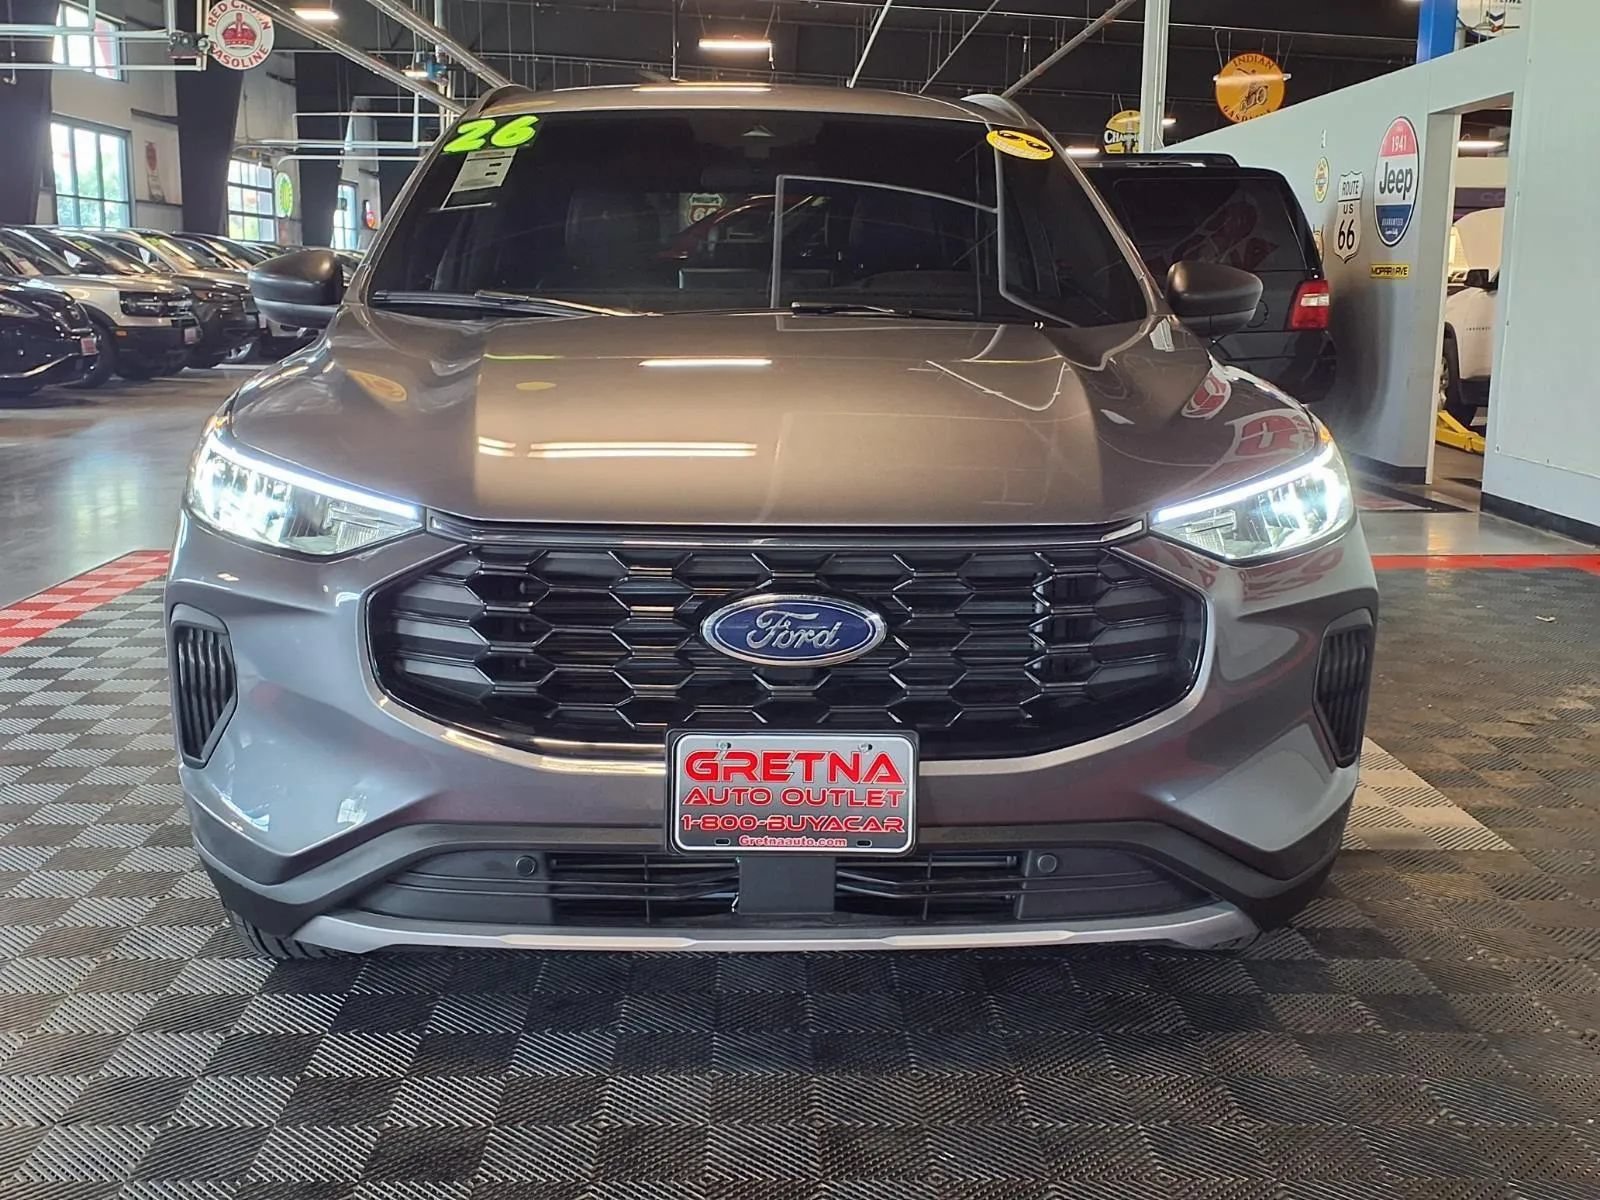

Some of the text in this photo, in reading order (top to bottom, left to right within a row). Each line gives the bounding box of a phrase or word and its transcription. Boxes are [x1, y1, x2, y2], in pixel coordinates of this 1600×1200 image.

[208, 2, 228, 28] RED
[1233, 55, 1274, 70] INDIAN
[443, 115, 539, 153] 26
[1391, 134, 1408, 153] 1941
[1342, 179, 1360, 196] ROUTE
[1379, 161, 1413, 200] Jeep
[1343, 203, 1354, 215] US
[1338, 219, 1355, 250] 66
[746, 610, 843, 649] Ford
[683, 749, 906, 785] GRETNA
[682, 786, 906, 808] AUTO OUTLET
[681, 814, 906, 833] 1-800-BUYACAR
[738, 835, 848, 848] Gretnaauto.com
